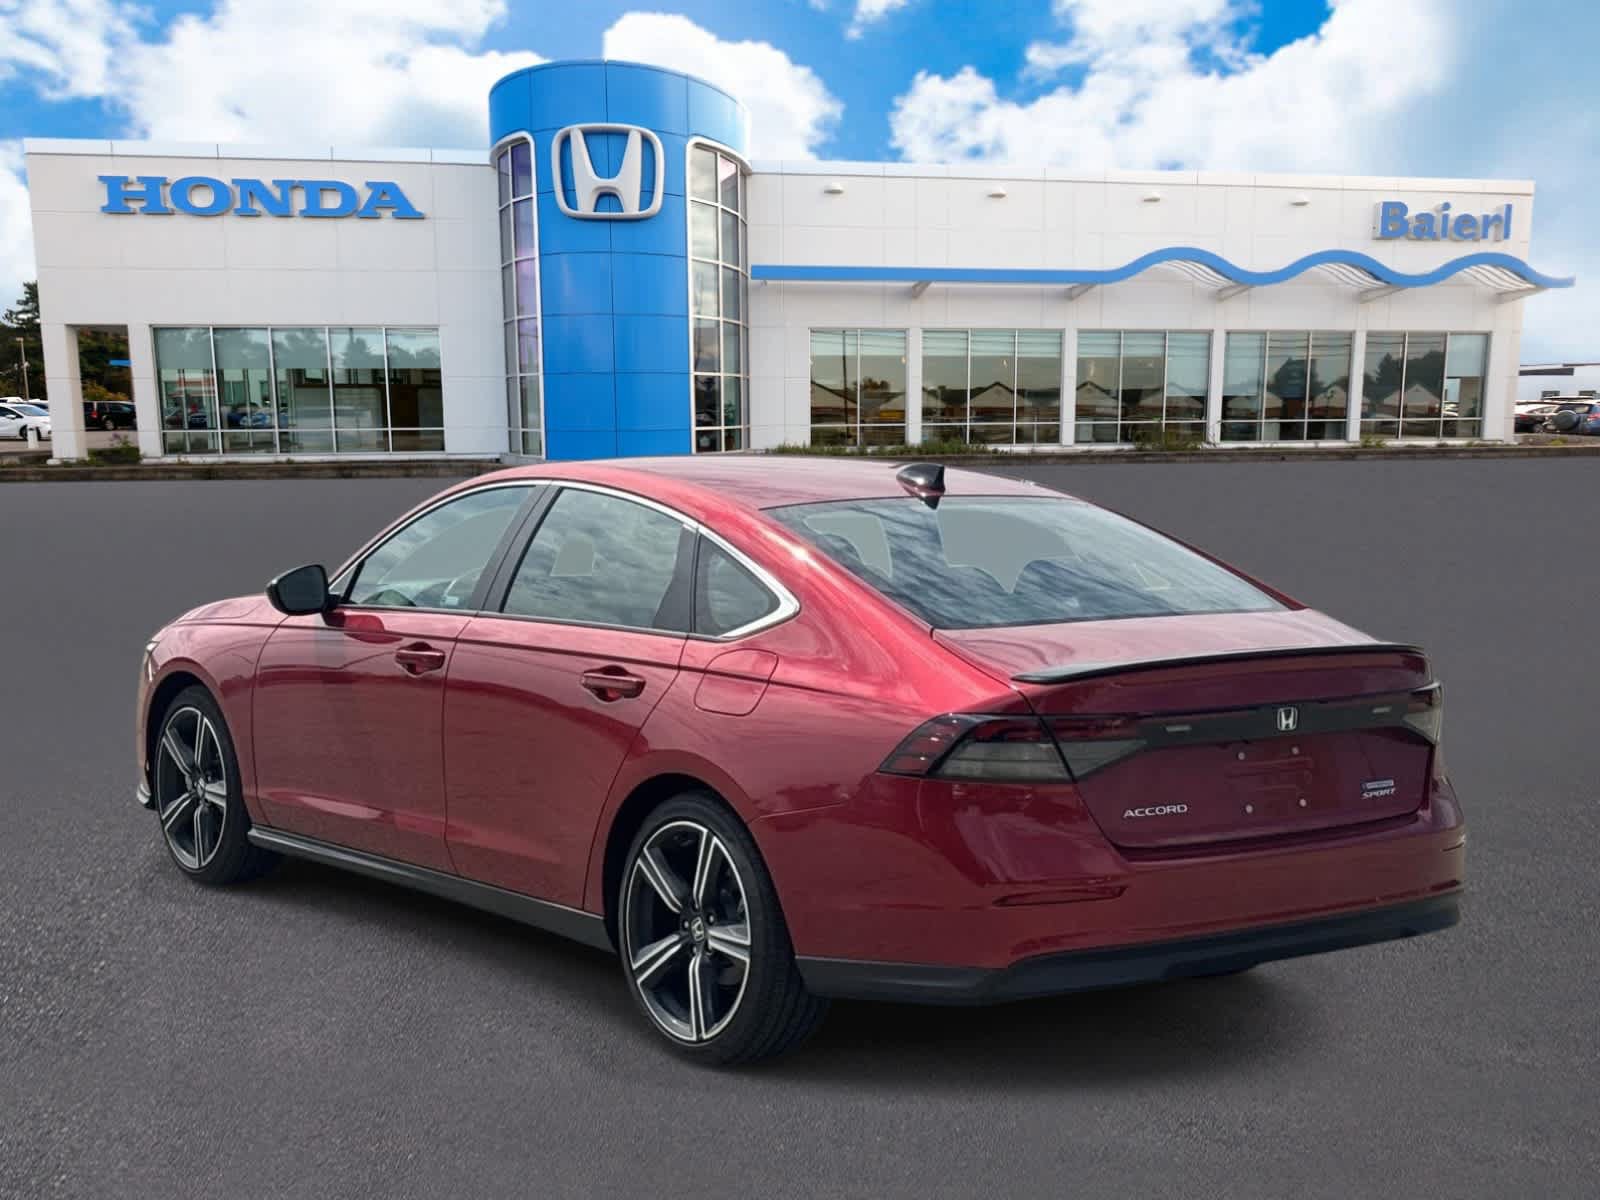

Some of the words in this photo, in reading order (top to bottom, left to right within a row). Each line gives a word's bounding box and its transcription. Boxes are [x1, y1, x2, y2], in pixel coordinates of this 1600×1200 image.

[98, 175, 424, 219] HONDA
[1378, 200, 1513, 240] Baierl
[1361, 787, 1397, 799] SPORT
[1123, 803, 1188, 817] ACCORD
